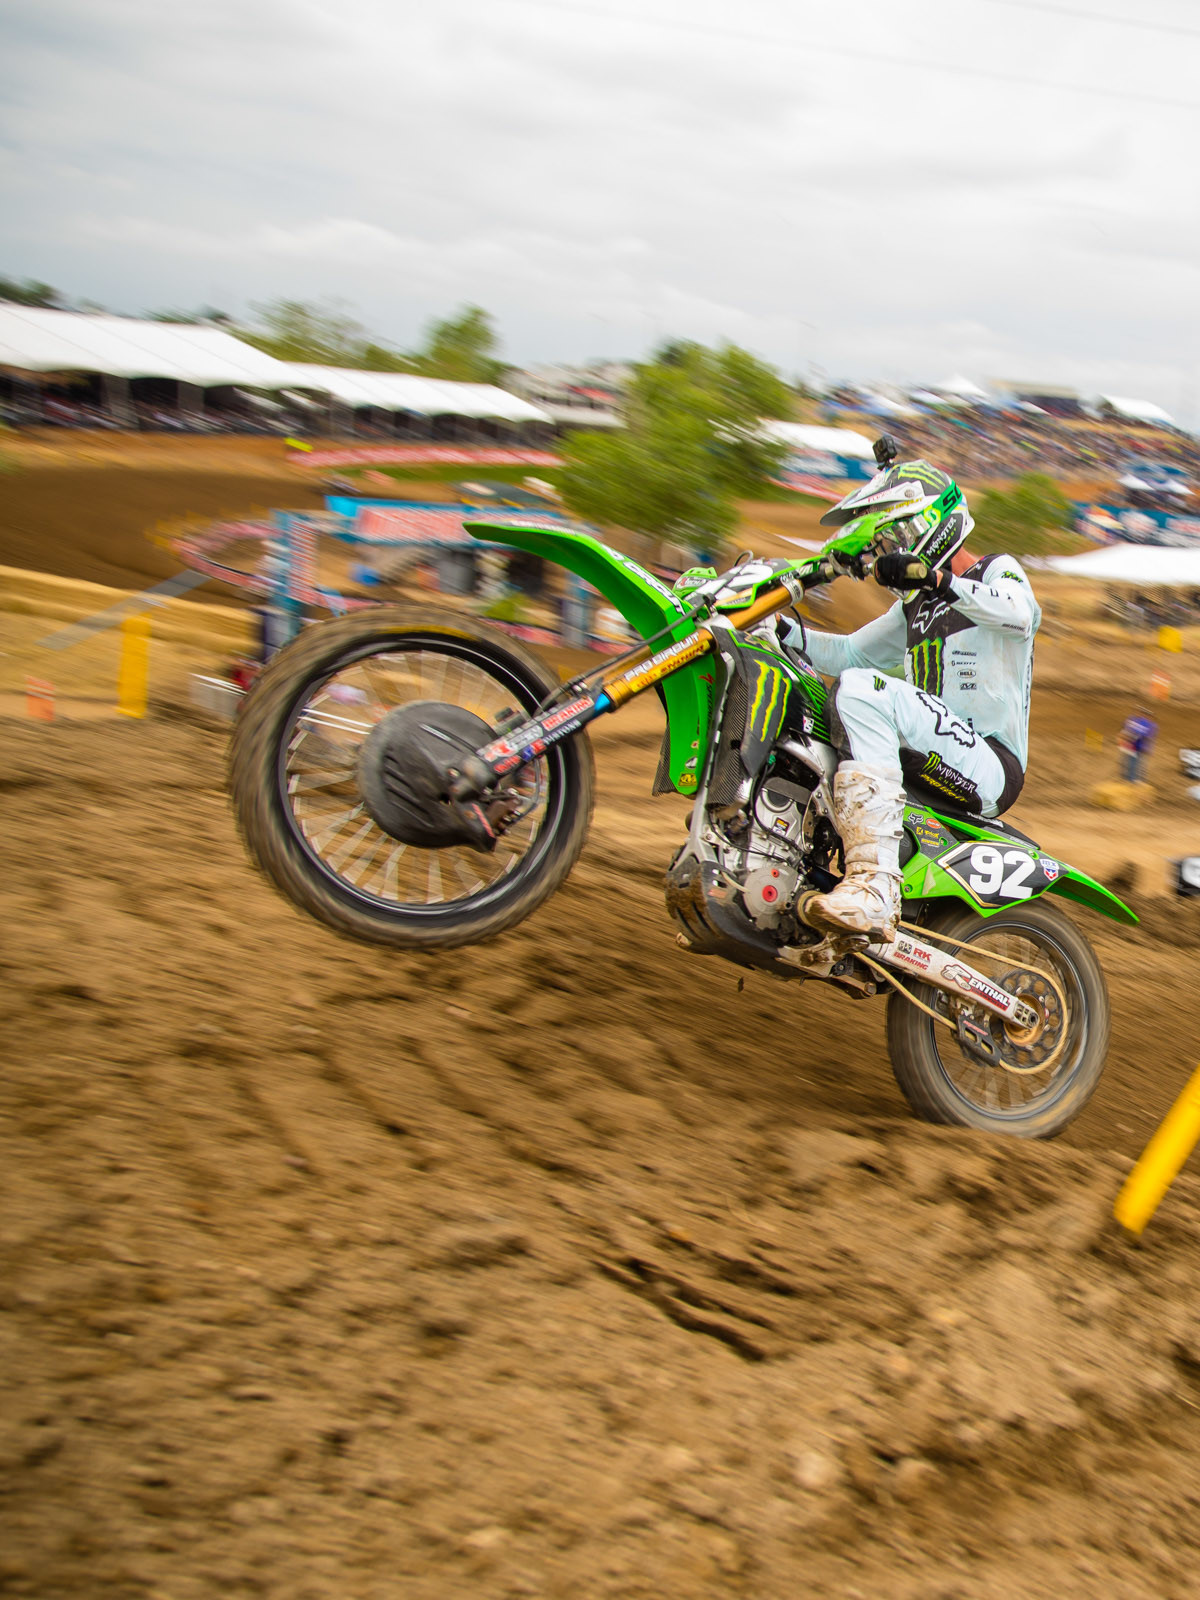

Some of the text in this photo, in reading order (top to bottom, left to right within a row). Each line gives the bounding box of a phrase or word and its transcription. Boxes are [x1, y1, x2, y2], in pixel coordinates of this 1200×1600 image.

[926, 517, 957, 556] MONSTER
[624, 658, 652, 682] PRO
[651, 632, 700, 666] CIRCUIT
[969, 845, 1036, 899] 92
[893, 951, 930, 971] BRAKING
[913, 947, 933, 962] RK
